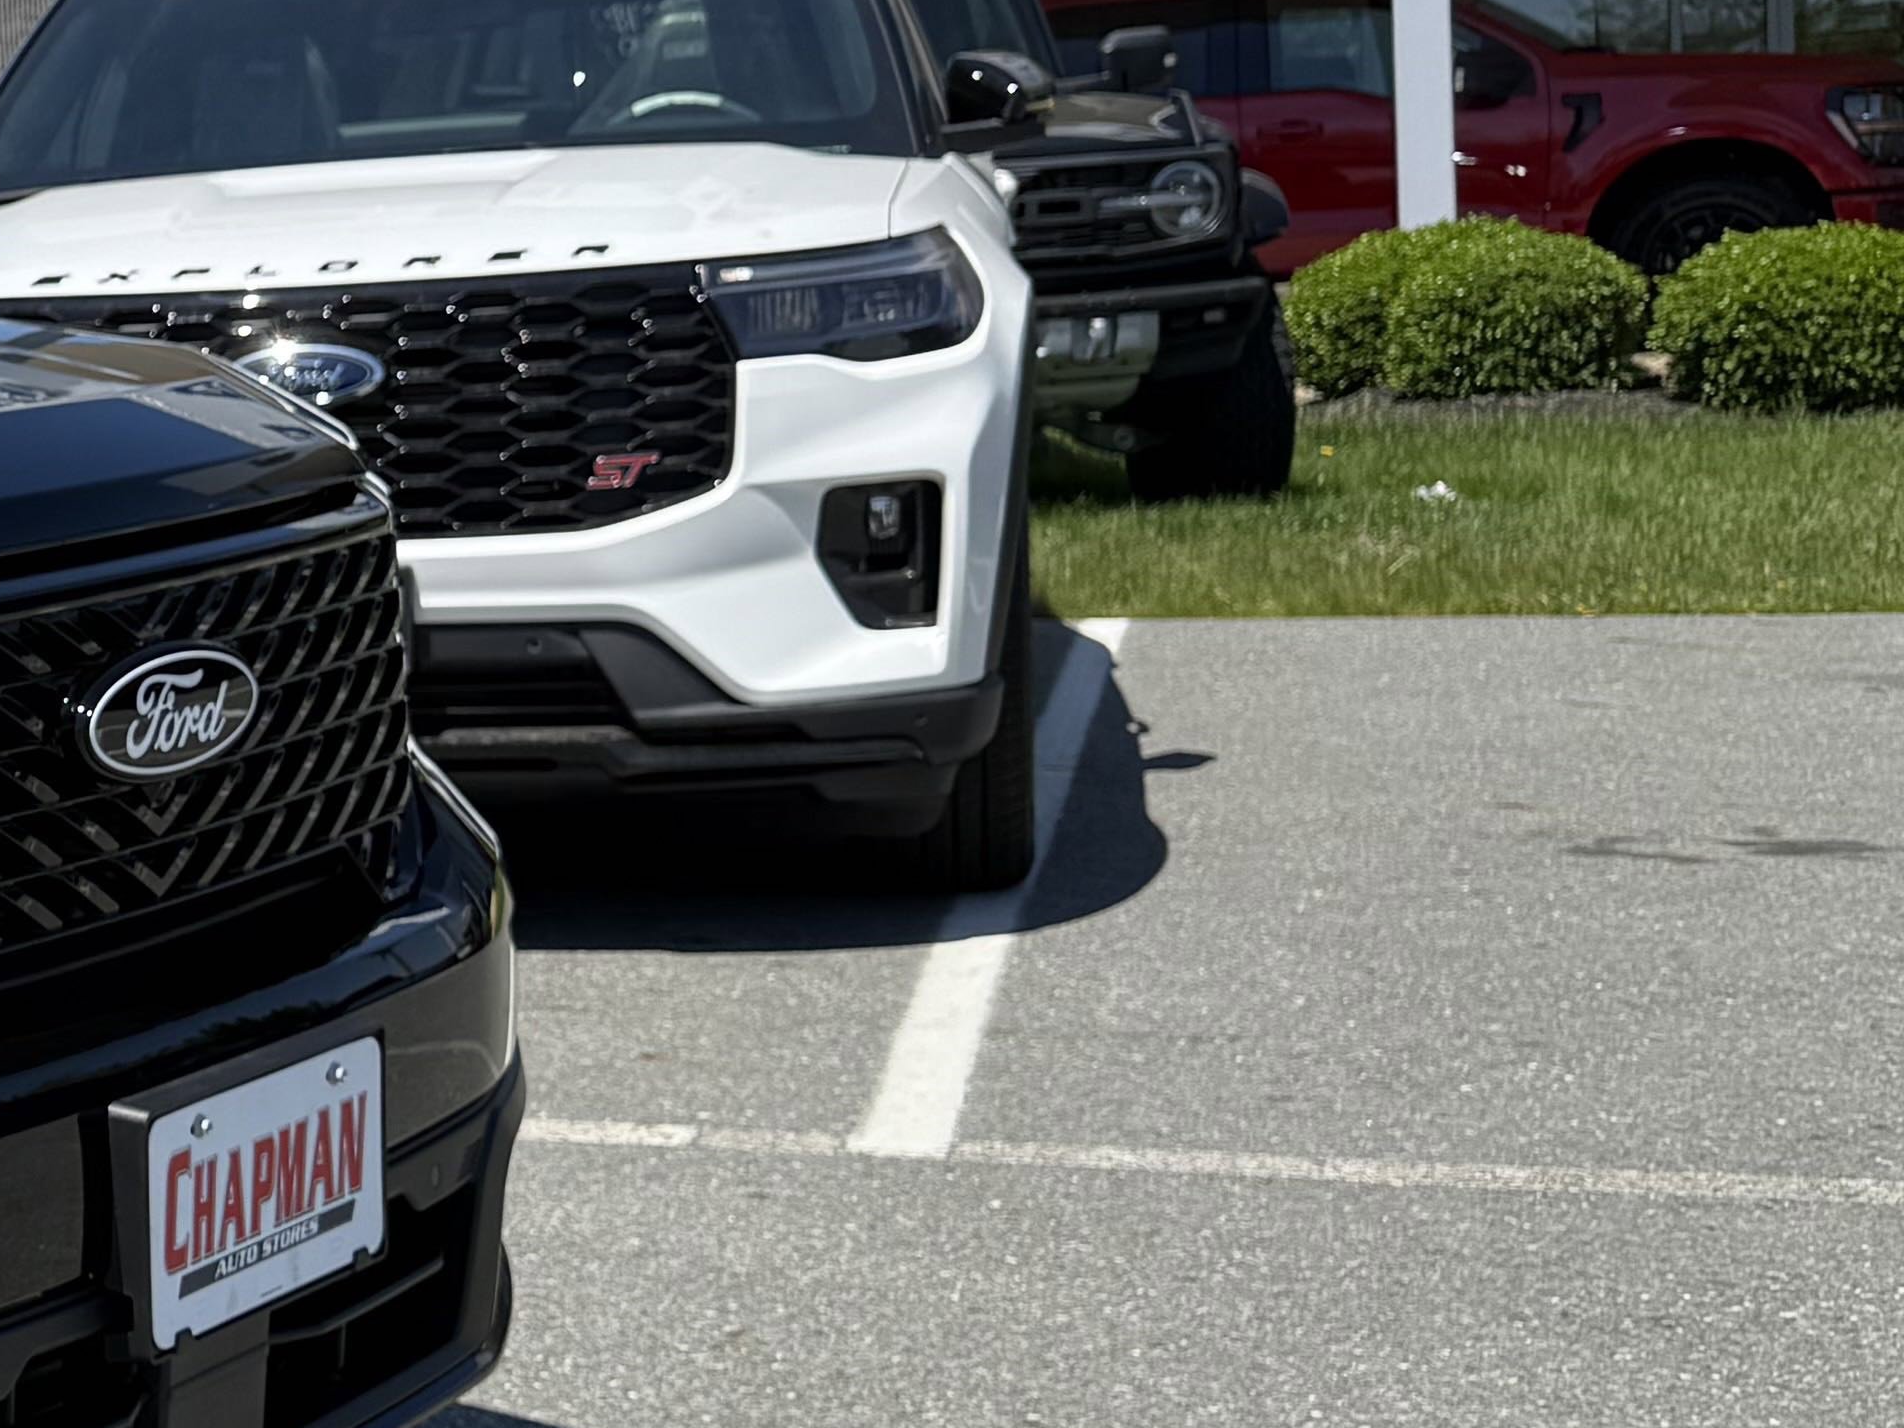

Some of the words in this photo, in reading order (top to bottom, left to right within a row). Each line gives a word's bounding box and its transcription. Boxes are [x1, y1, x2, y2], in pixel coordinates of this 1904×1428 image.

[32, 244, 610, 286] EXPLORER
[586, 453, 660, 490] ST
[125, 667, 229, 760] Ford
[164, 1090, 368, 1276] CHAPMAN
[213, 1246, 259, 1280] AUTO
[260, 1217, 320, 1258] STORES
